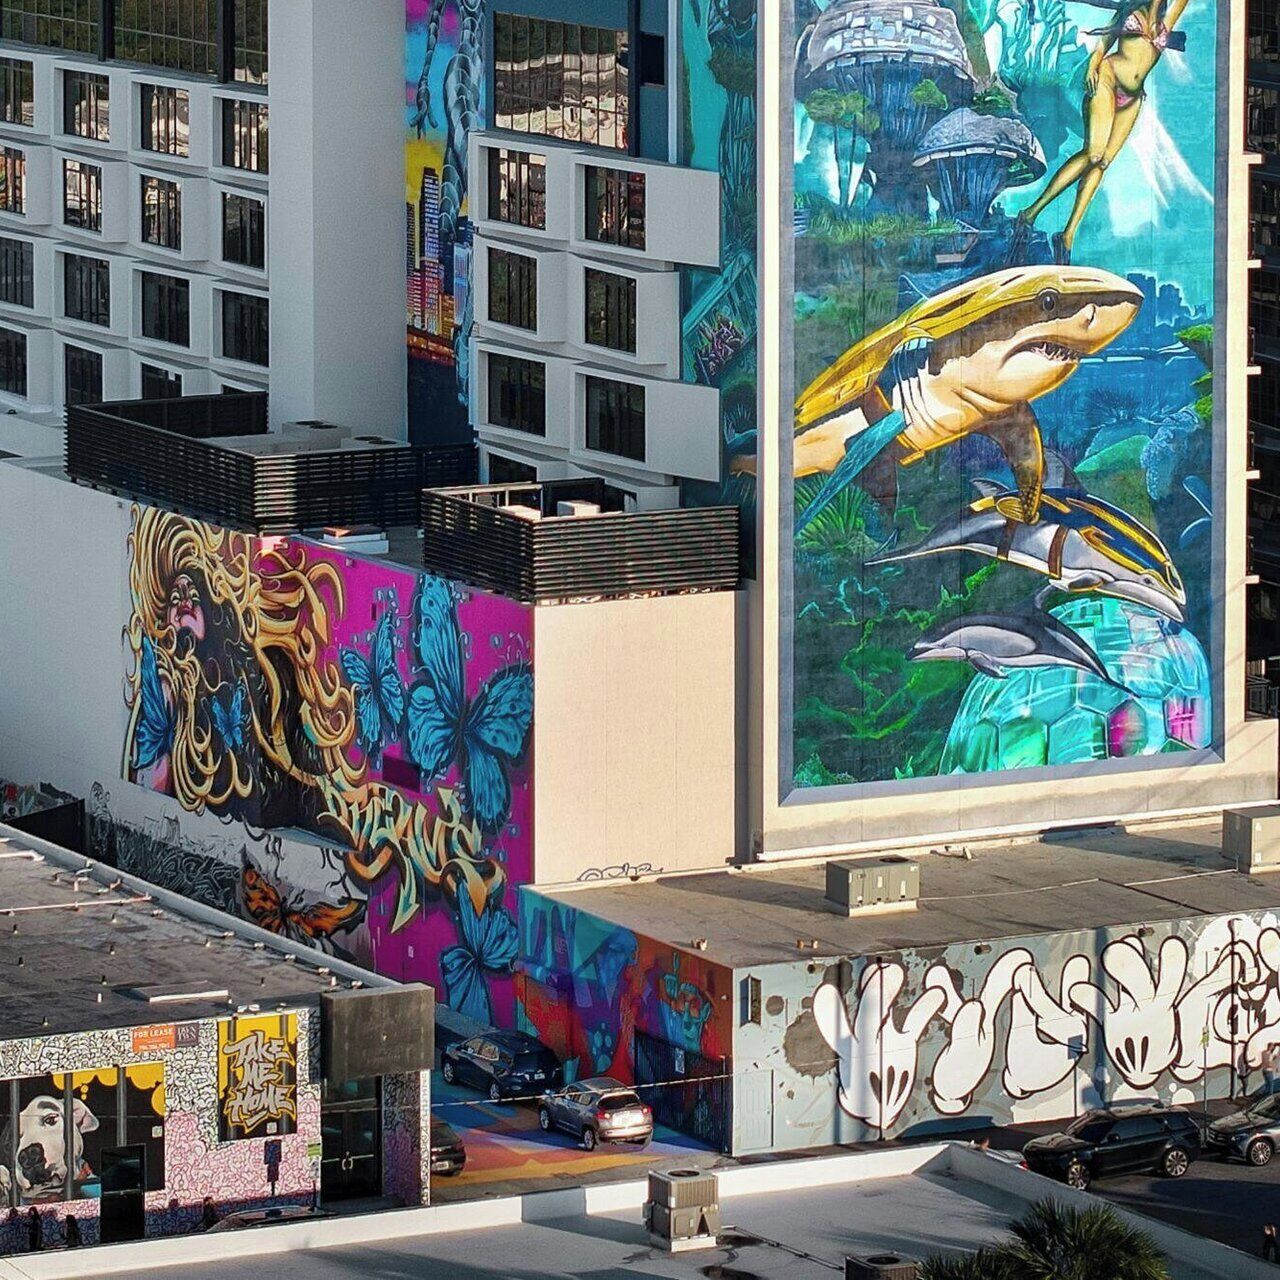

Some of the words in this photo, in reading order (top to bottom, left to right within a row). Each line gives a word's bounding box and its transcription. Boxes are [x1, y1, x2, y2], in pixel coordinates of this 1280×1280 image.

[133, 1031, 149, 1039] FOR
[150, 1027, 173, 1037] LEASE
[223, 1030, 295, 1070] TAKE
[237, 1060, 283, 1091] ME
[225, 1084, 296, 1128] HOME
